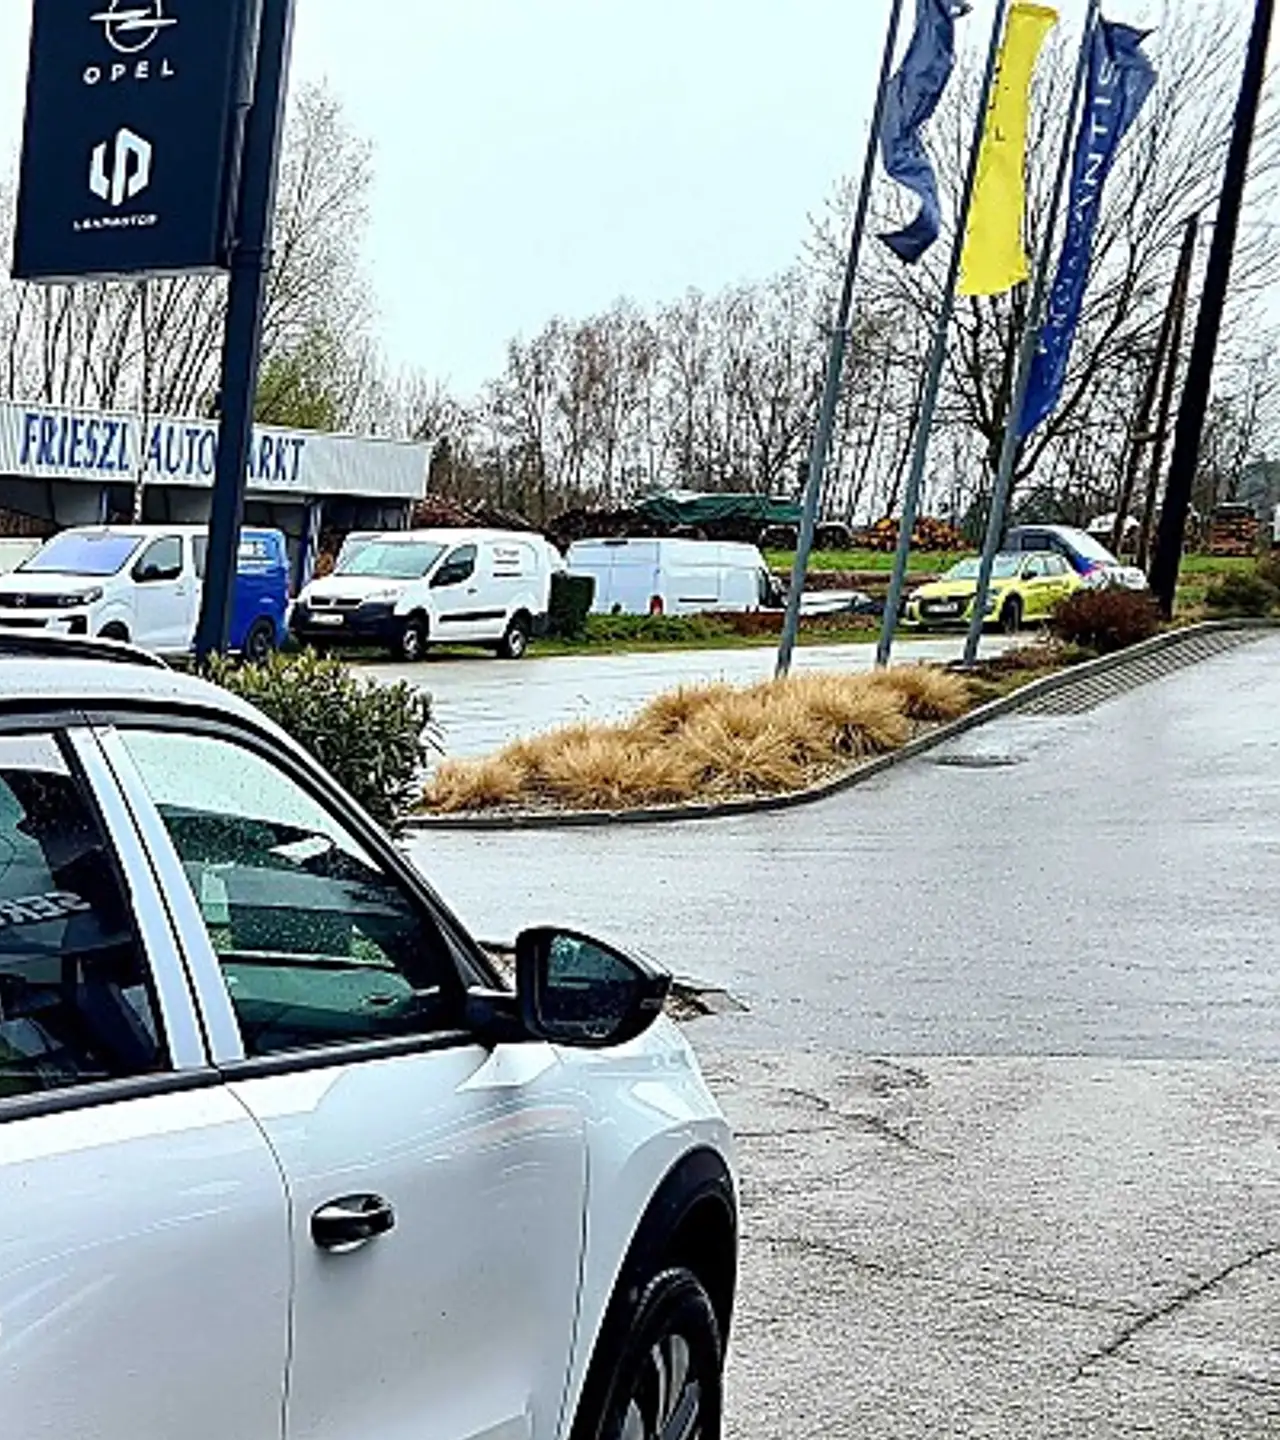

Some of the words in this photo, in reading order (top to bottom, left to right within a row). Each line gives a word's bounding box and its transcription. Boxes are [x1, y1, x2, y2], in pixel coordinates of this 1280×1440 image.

[83, 57, 175, 85] OPEL
[20, 412, 131, 472] FRIESZL
[144, 423, 305, 481] AUTOARKT
